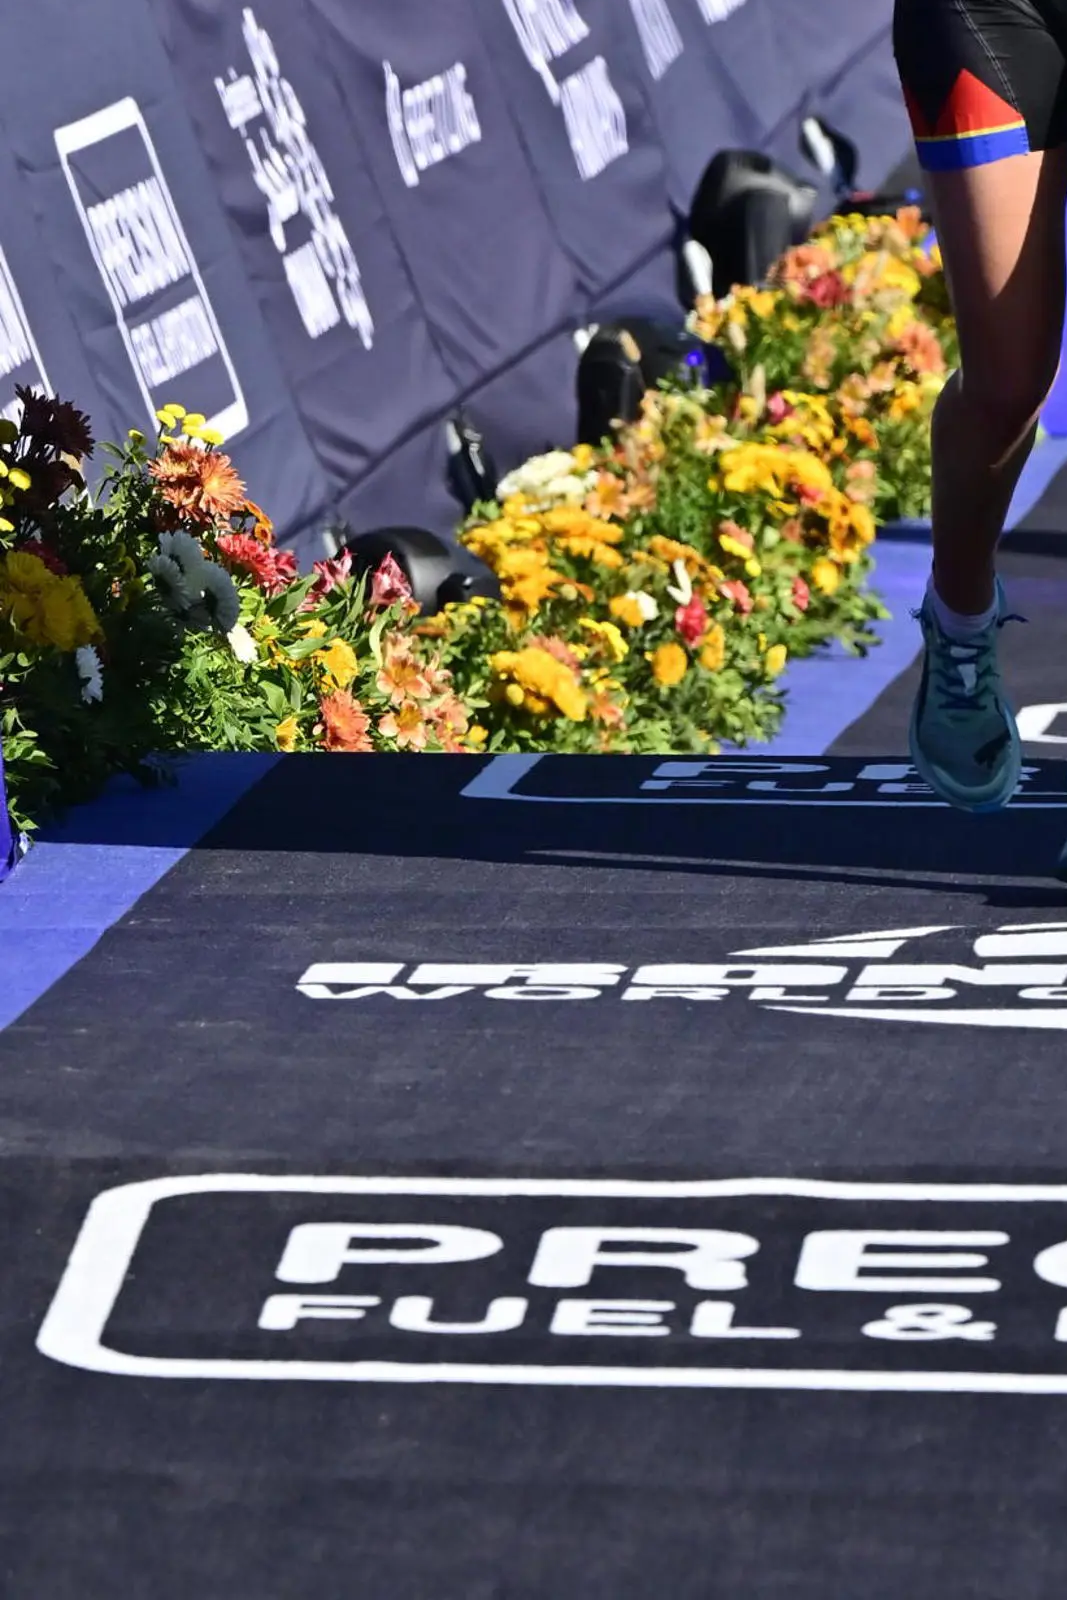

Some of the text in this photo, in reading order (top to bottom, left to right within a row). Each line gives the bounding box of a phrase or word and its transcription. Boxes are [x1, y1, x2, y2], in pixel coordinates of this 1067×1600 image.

[295, 983, 957, 1001] WORLD
[258, 1294, 800, 1339] FUEL
[861, 1303, 998, 1341] &
